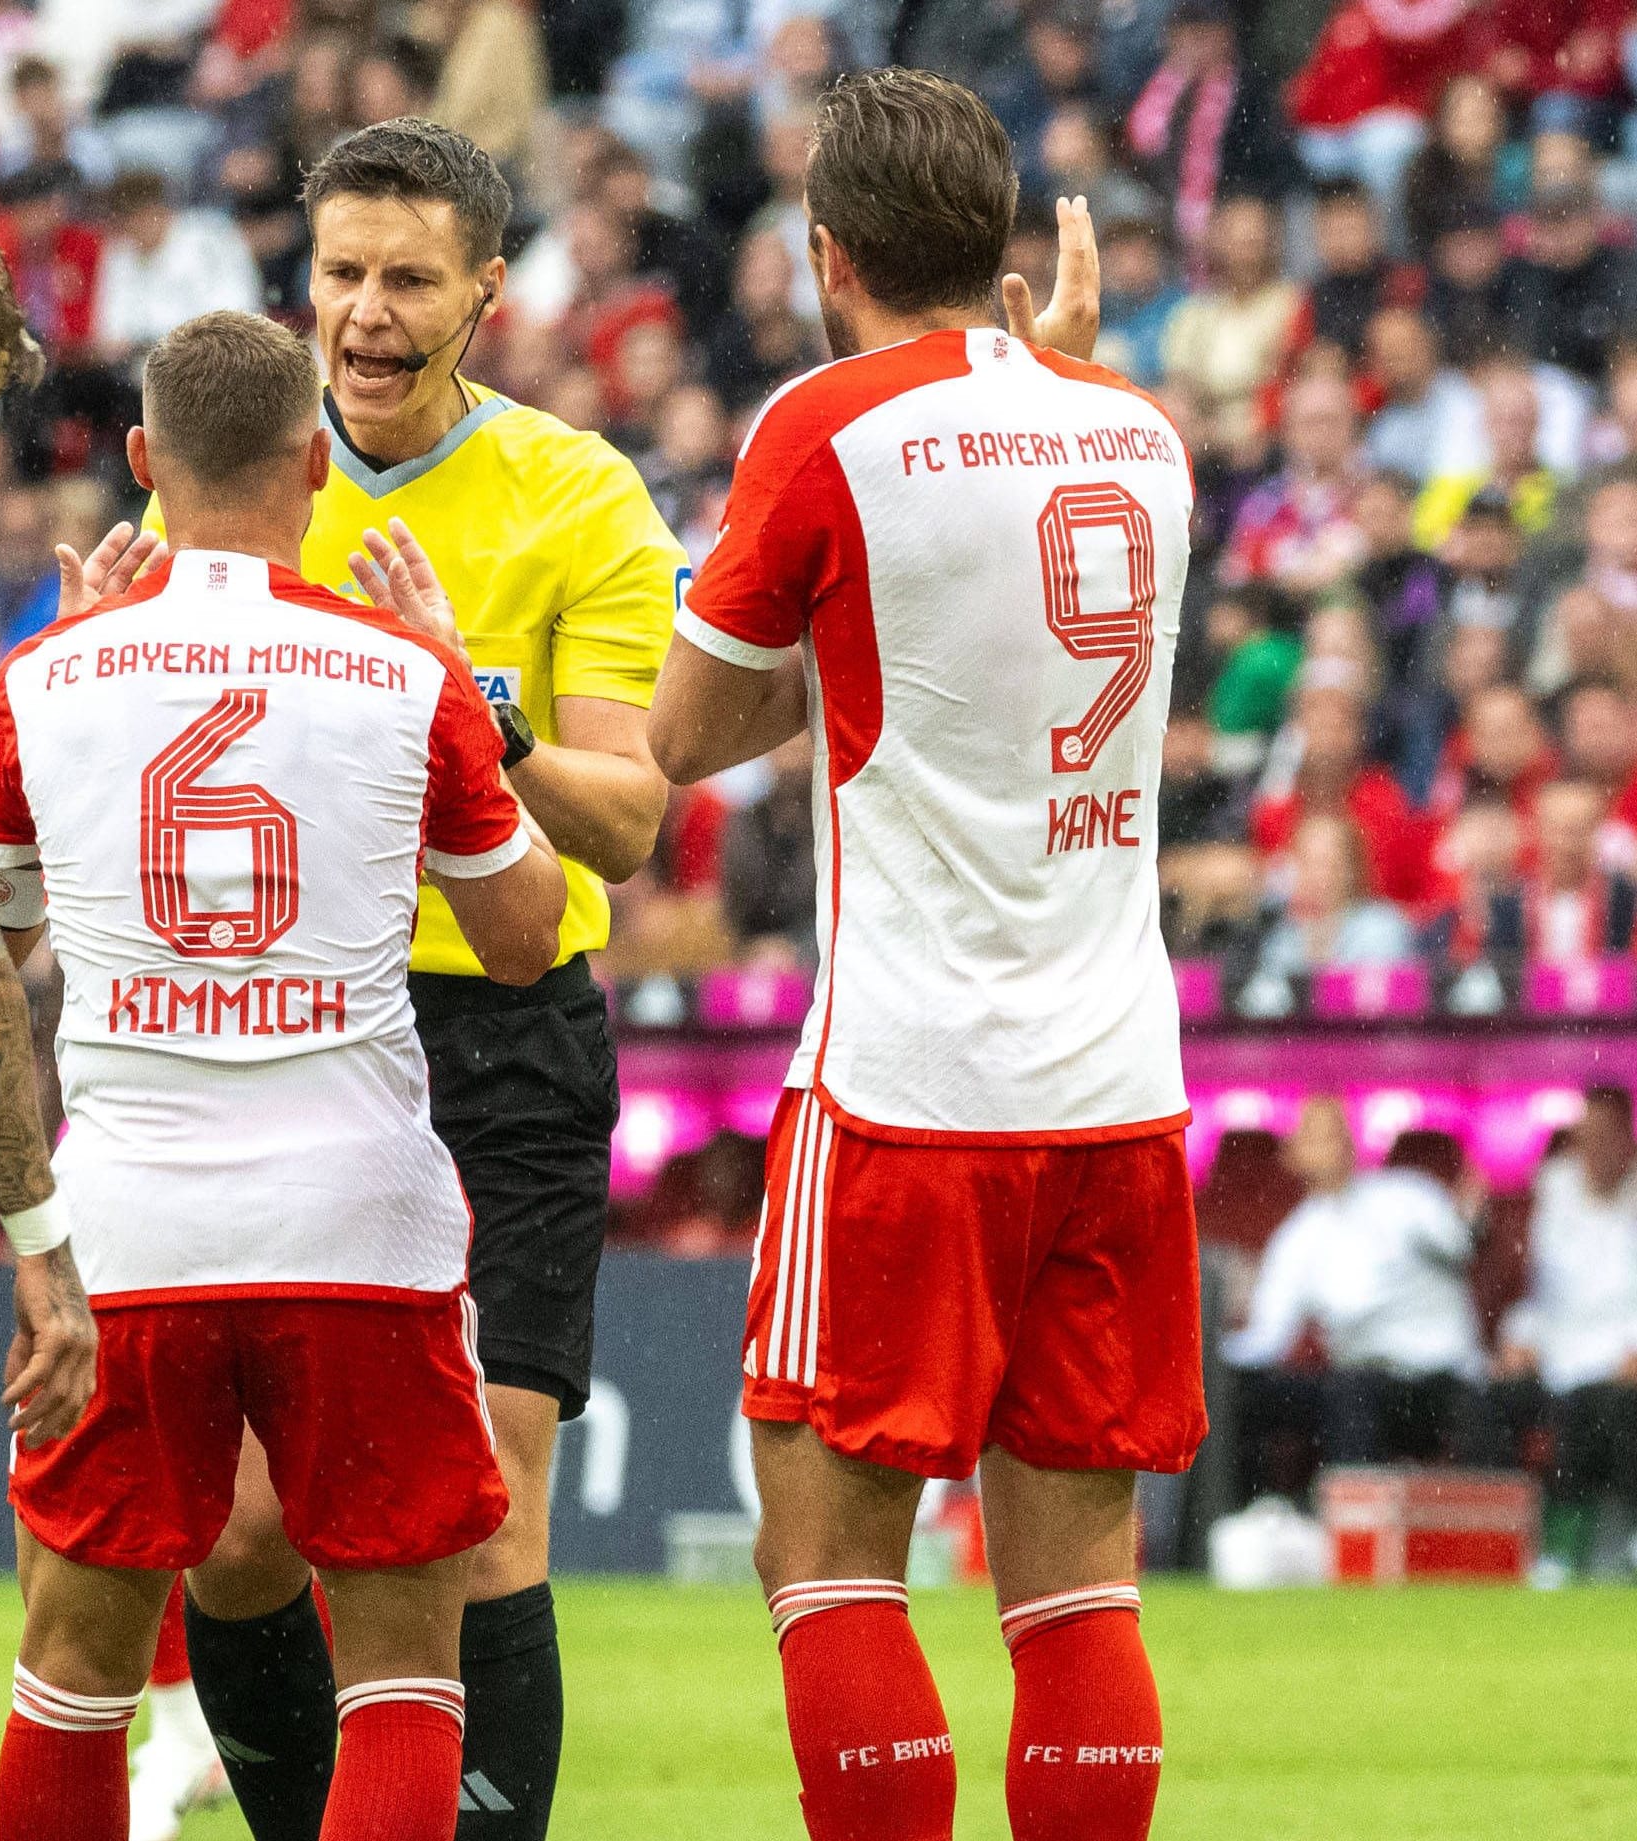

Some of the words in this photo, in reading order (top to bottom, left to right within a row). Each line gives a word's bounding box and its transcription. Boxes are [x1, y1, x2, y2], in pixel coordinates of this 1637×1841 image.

[901, 436, 946, 476] FC
[957, 431, 1069, 468] BAYERN
[1075, 426, 1177, 468] MÜNCHEN
[209, 561, 228, 573] MIA
[209, 574, 228, 584] SAN
[1038, 482, 1156, 773] 9
[46, 653, 83, 690] FC
[96, 641, 230, 678] BAYERN
[248, 643, 407, 693] MÜNCHEN
[140, 689, 299, 957] 6
[1046, 789, 1141, 855] KANE
[108, 977, 346, 1035] KIMMICH
[839, 1745, 880, 1771] FC
[892, 1733, 954, 1762] BAYE
[1024, 1745, 1063, 1763] FC
[1076, 1745, 1164, 1764] BAYER
